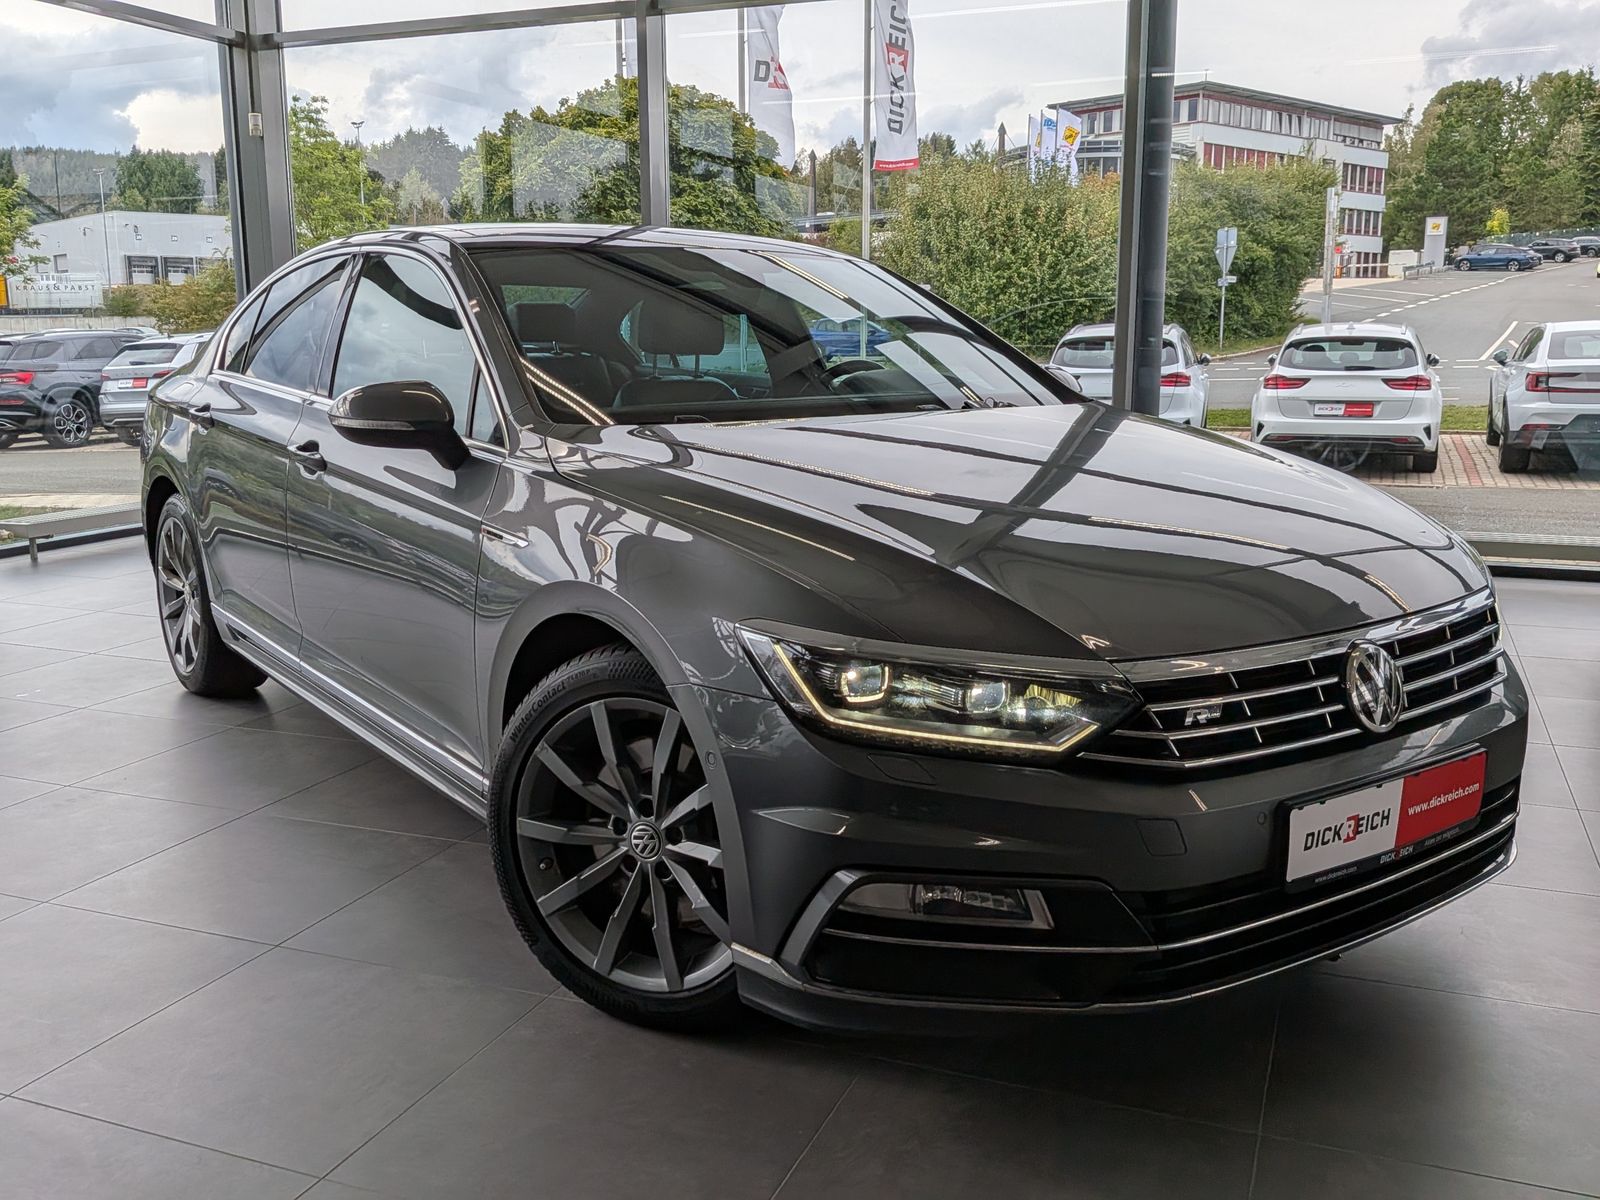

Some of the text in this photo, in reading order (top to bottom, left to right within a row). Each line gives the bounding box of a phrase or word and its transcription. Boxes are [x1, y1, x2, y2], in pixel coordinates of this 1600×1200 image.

[885, 0, 909, 135] DICKREIC
[53, 282, 60, 291] &
[509, 680, 568, 743] WinterContact
[1407, 782, 1480, 816] www.dickreich.com
[1303, 808, 1391, 851] DICKREICH
